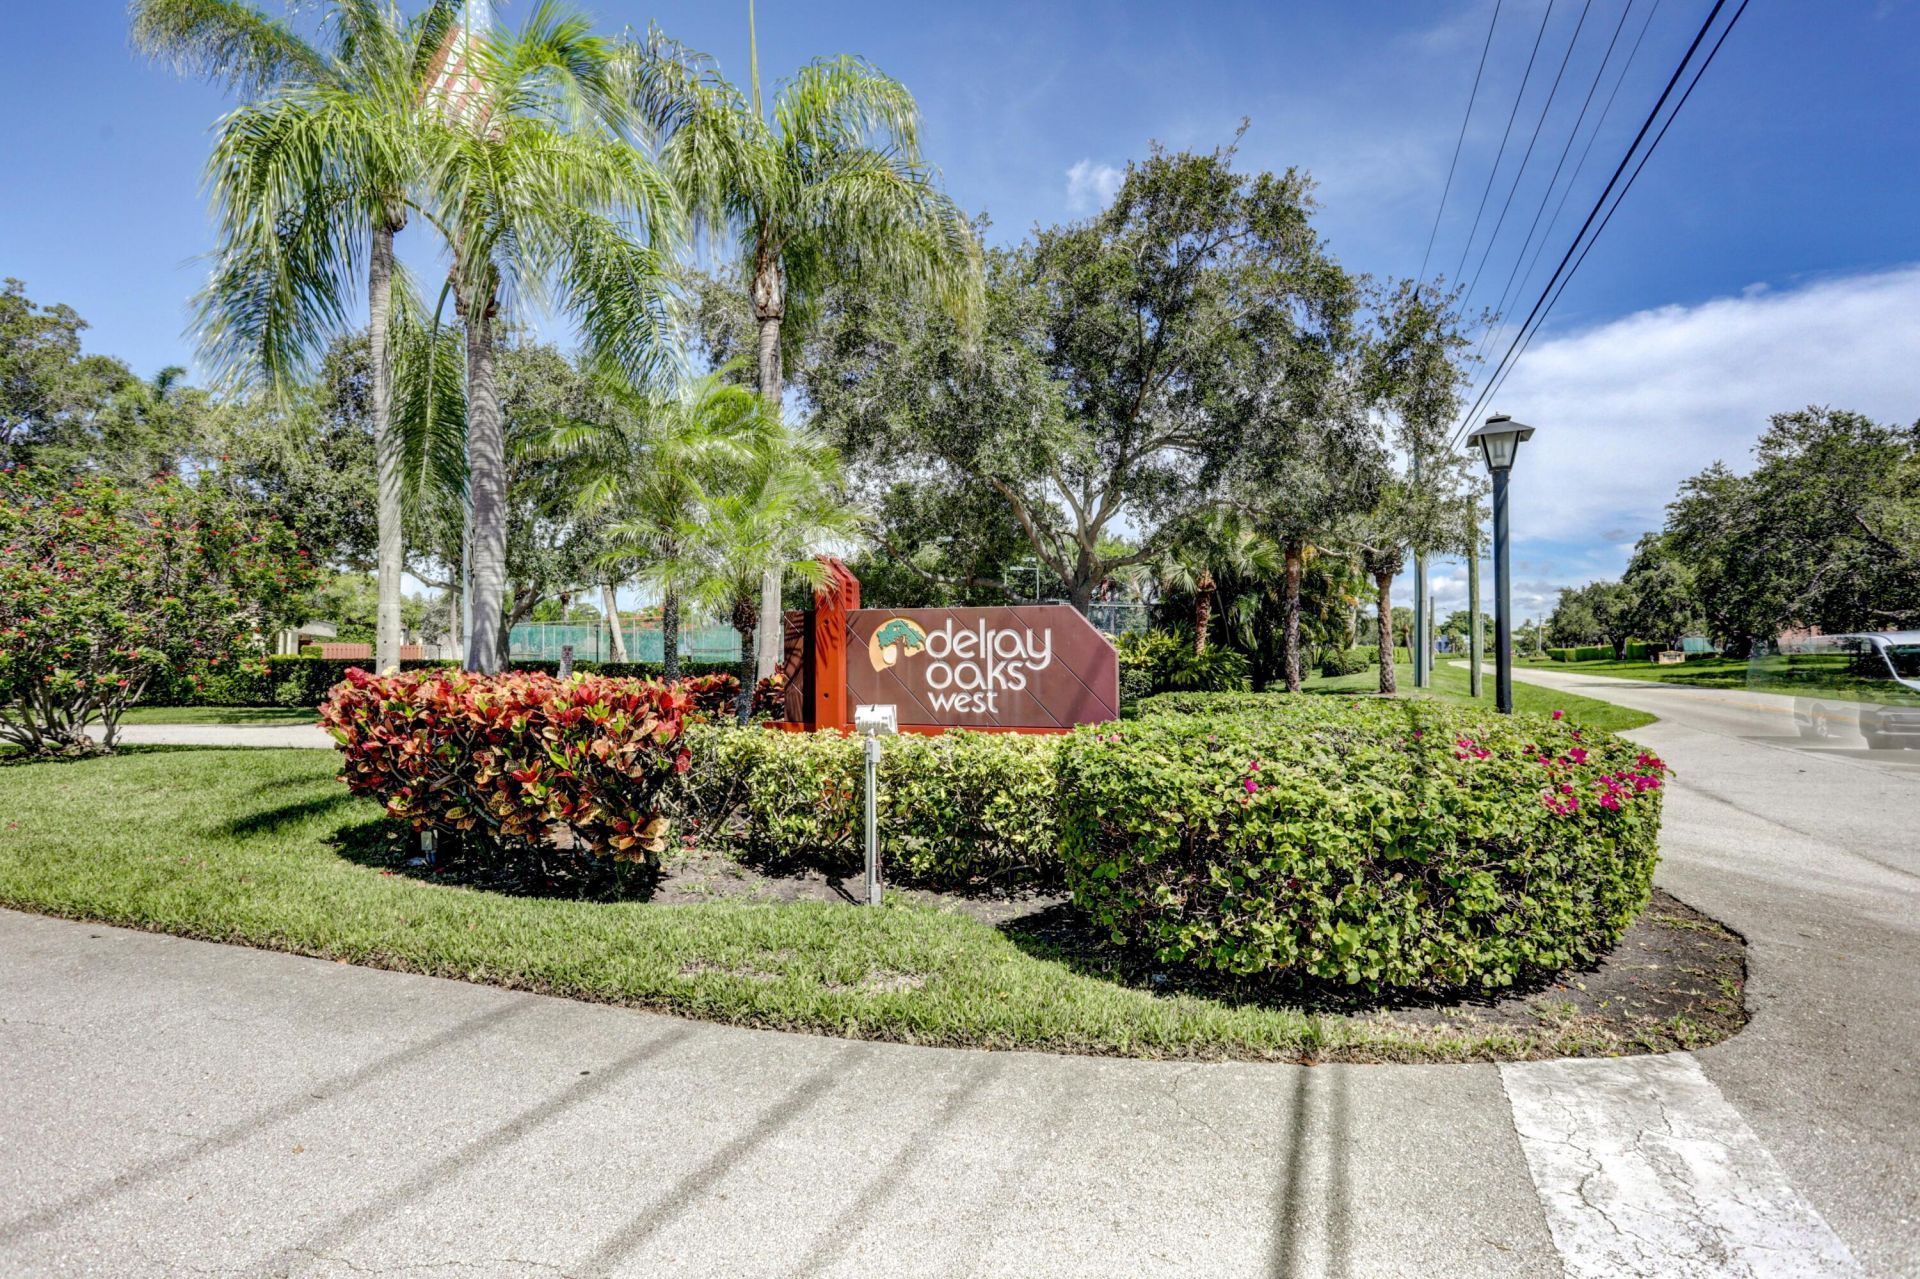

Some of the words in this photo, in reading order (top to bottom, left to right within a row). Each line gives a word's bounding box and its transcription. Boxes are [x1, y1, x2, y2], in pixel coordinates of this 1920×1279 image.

[925, 617, 1051, 670] delray
[926, 657, 1027, 690] oaks
[928, 691, 999, 714] west
